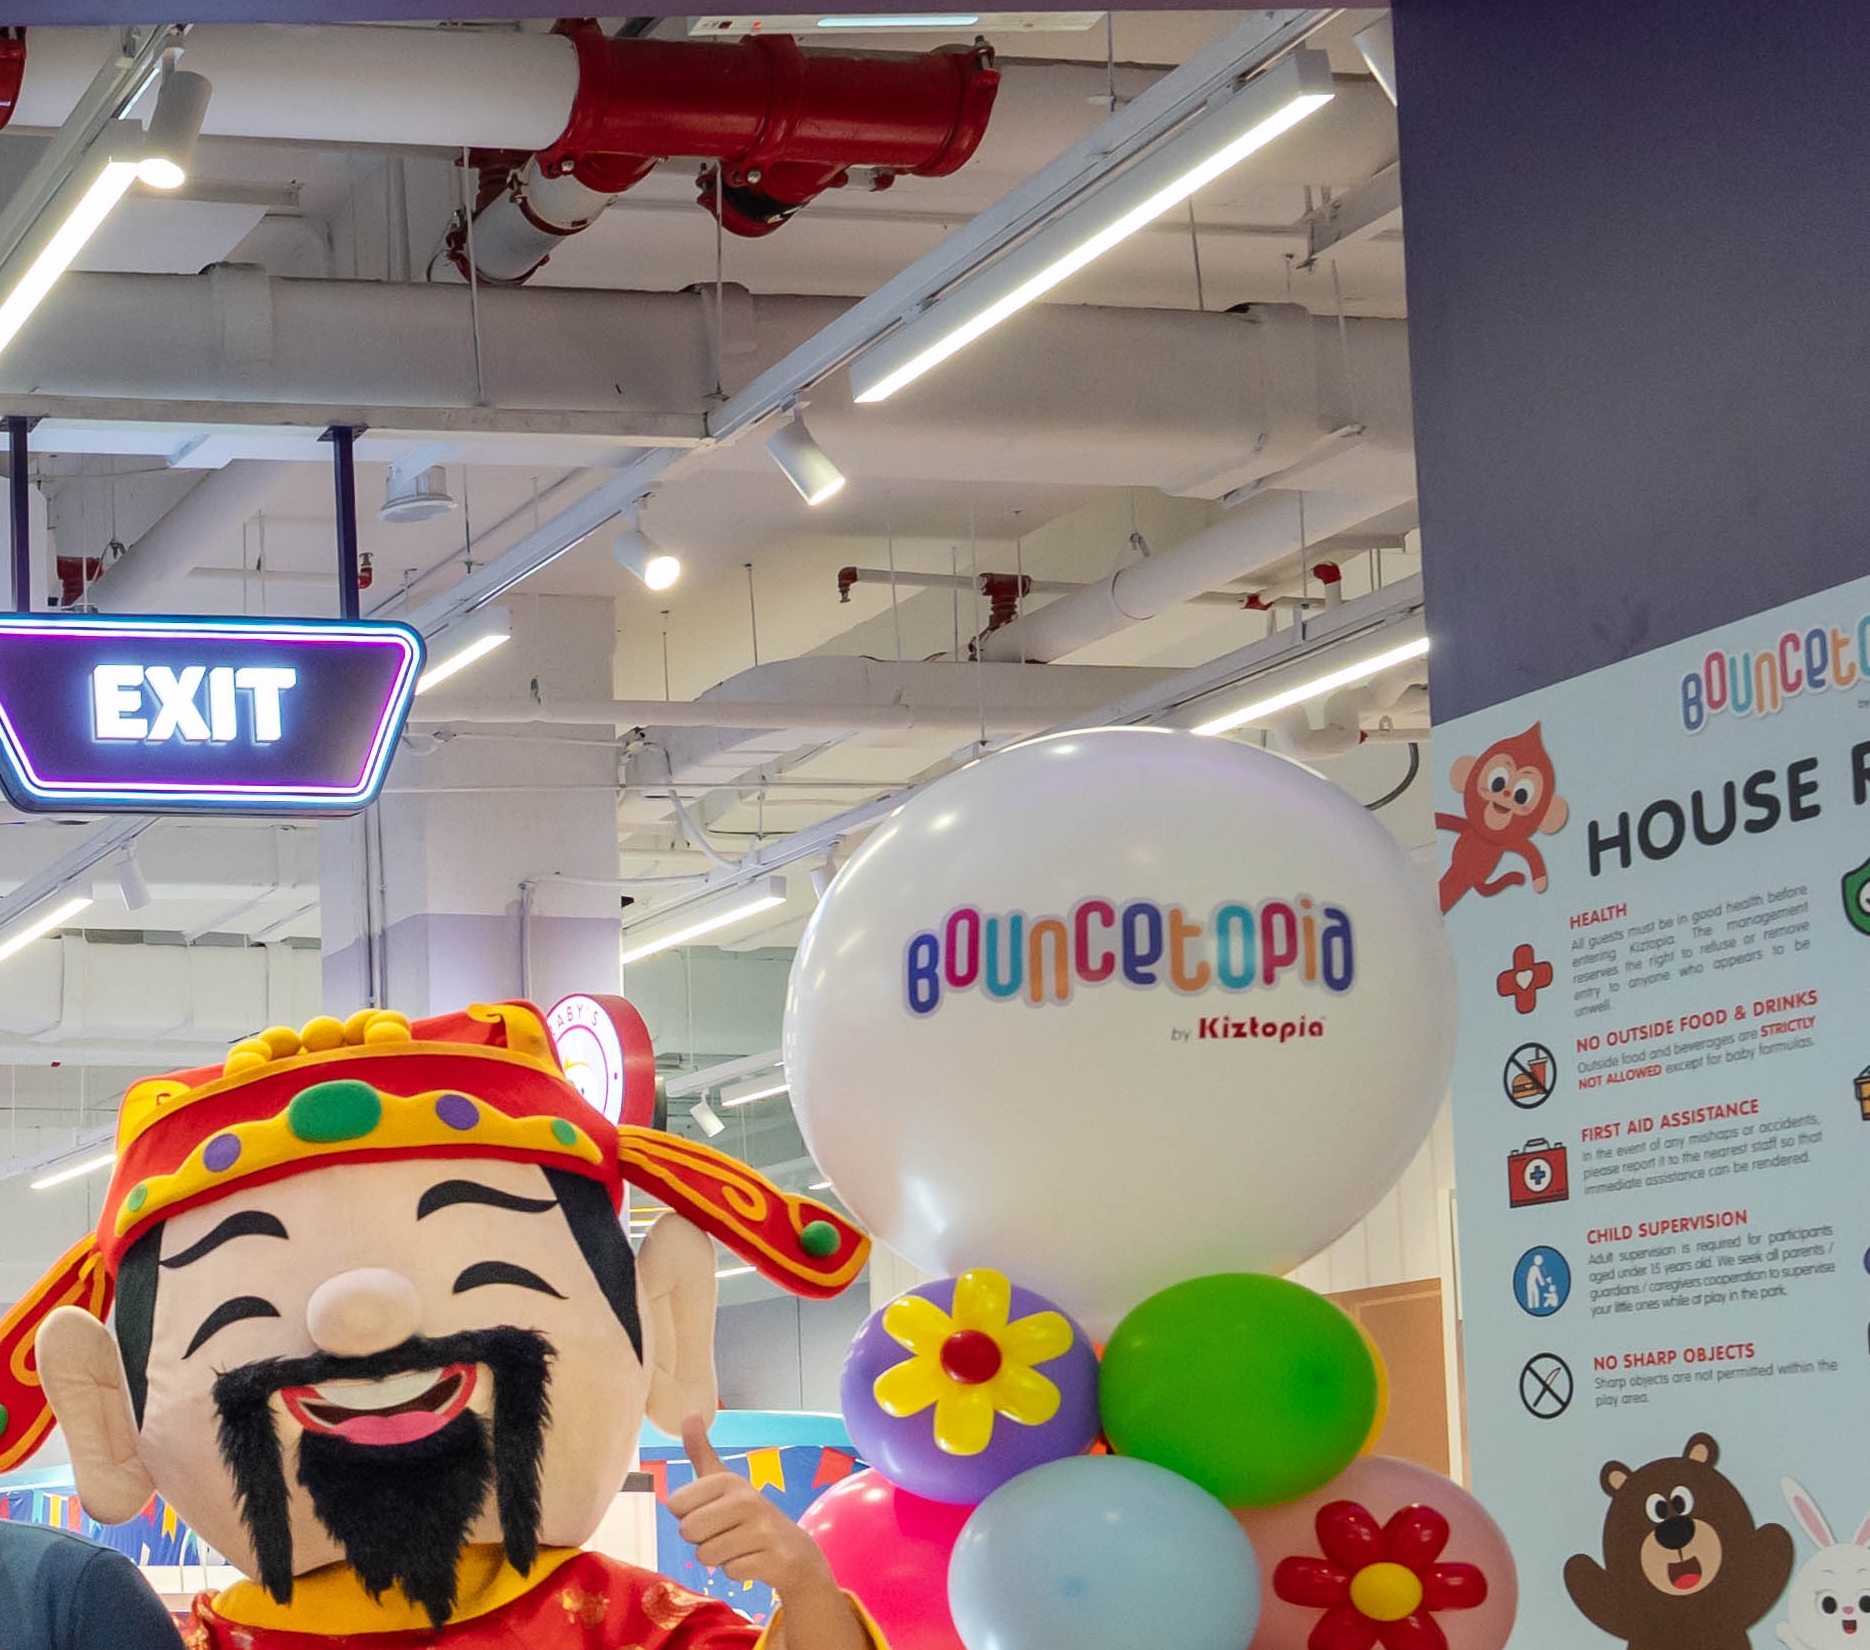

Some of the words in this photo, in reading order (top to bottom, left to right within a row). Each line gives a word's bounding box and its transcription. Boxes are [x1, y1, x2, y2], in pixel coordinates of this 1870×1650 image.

[92, 664, 297, 742] EXIT
[1587, 757, 1821, 877] HOUSE
[1570, 902, 1627, 929] HEALTH
[549, 1004, 599, 1036] ABY'S
[1170, 1026, 1192, 1043] by
[1198, 1015, 1324, 1042] Kiztopia
[1576, 1035, 1600, 1053] NO
[1607, 1020, 1674, 1047] OUTSIDE
[1680, 1009, 1727, 1032] FOOD
[1734, 1005, 1746, 1020] &
[1753, 990, 1818, 1017] DRINKS
[1578, 1057, 1619, 1073] Outside
[1622, 1050, 1646, 1065] food
[1649, 1045, 1671, 1060] and
[1674, 1033, 1735, 1054] beverages
[1738, 1030, 1758, 1042] are
[1760, 1016, 1816, 1037] STRICTLY
[1578, 1076, 1602, 1090] NOT
[1606, 1064, 1662, 1085] ALLOWED
[1666, 1057, 1704, 1075] except
[1707, 1053, 1722, 1065] for
[1726, 1049, 1756, 1063] baby
[1581, 1123, 1621, 1142] FIRST
[1627, 1117, 1654, 1135] AID
[1660, 1099, 1759, 1129] ASSISTANCE
[1583, 1165, 1619, 1181] please
[1623, 1158, 1656, 1174] report
[1668, 1155, 1679, 1166] to
[1682, 1151, 1700, 1162] the
[1703, 1142, 1748, 1160] nearest
[1751, 1137, 1777, 1152] staff
[1781, 1136, 1795, 1147] so
[1799, 1131, 1822, 1144] that
[1596, 1148, 1613, 1158] the
[1617, 1142, 1646, 1156] event
[1650, 1138, 1661, 1151] of
[1664, 1137, 1685, 1149] any
[1689, 1129, 1739, 1144] mishaps
[1743, 1125, 1755, 1136] or
[1584, 1179, 1642, 1195] immediate
[1646, 1168, 1705, 1186] assistance
[1709, 1165, 1729, 1177] can
[1733, 1161, 1748, 1173] be
[1587, 1225, 1632, 1245] CHILD
[1639, 1210, 1748, 1237] SUPERVISION
[1594, 1355, 1618, 1371] NO
[1623, 1349, 1676, 1369] SHARP
[1683, 1343, 1755, 1363] OBJECTS
[1595, 1377, 1626, 1391] Sharp
[1630, 1372, 1669, 1388] objects
[1672, 1371, 1691, 1383] are
[1695, 1370, 1713, 1381] not
[1717, 1364, 1773, 1382] permitted
[1778, 1361, 1814, 1375] within
[1818, 1359, 1838, 1371] the
[1595, 1395, 1619, 1408] play
